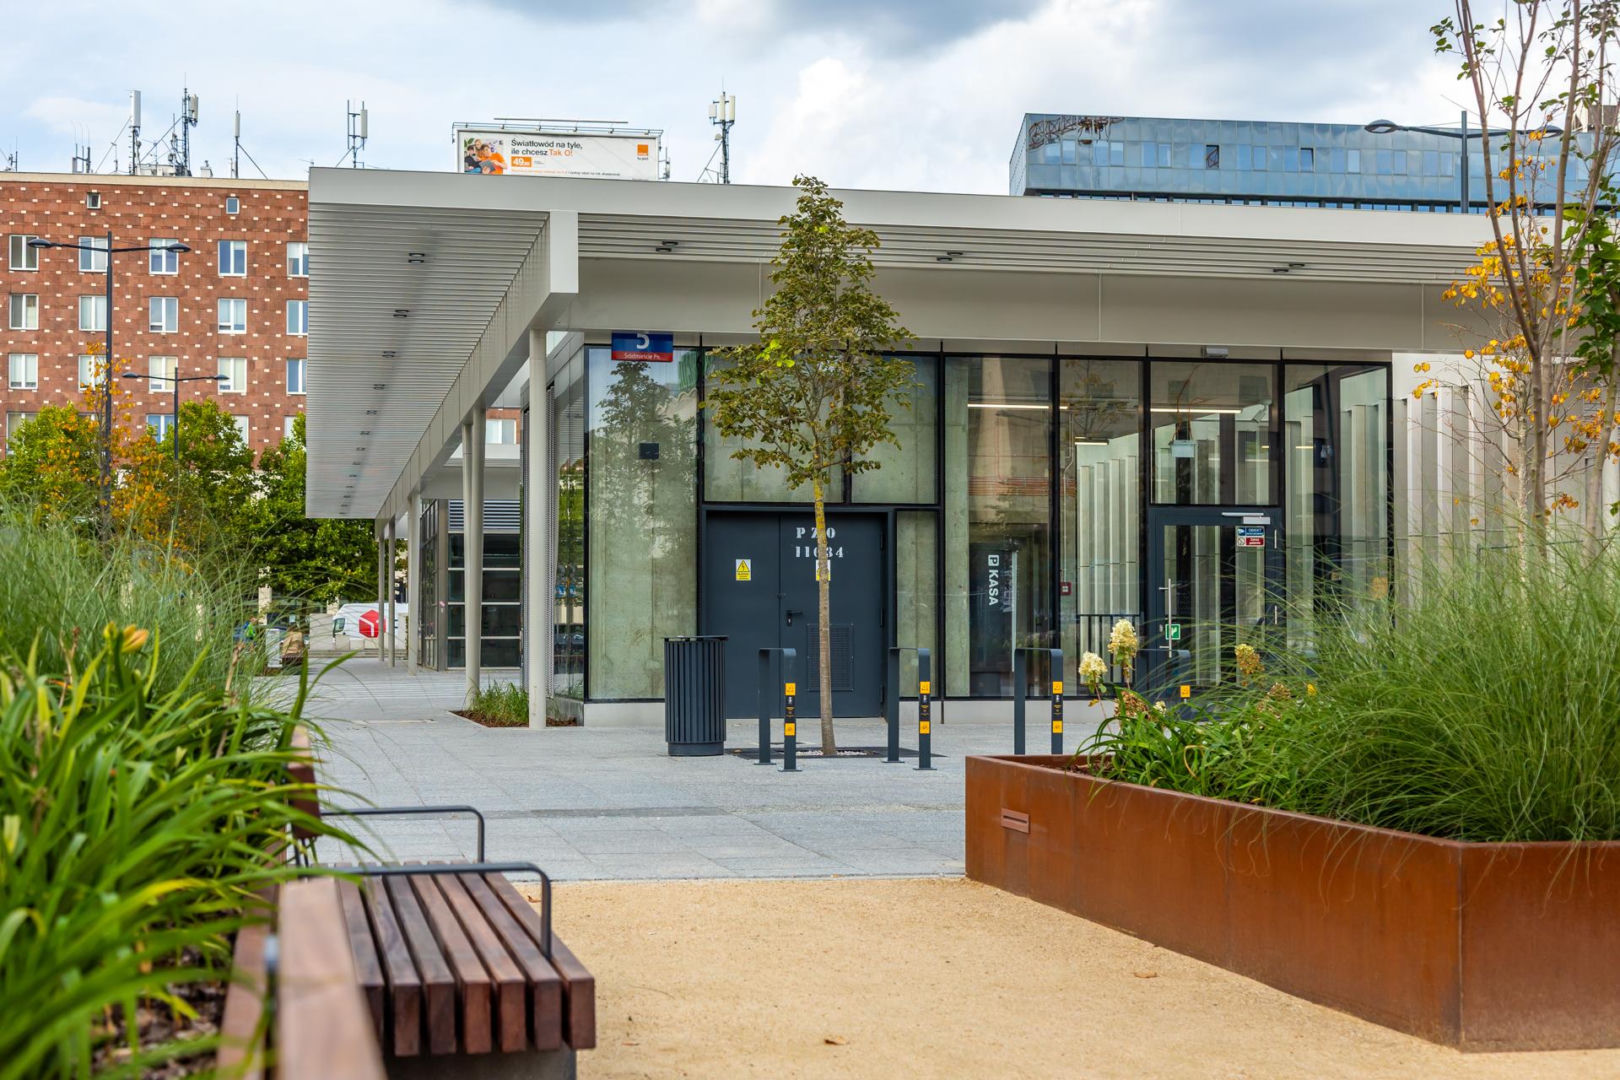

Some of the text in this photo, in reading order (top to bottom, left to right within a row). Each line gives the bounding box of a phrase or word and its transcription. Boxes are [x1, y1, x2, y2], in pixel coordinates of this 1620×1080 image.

[511, 138, 554, 148] Światłowód
[521, 148, 548, 156] chcesz
[989, 570, 998, 605] KASA
